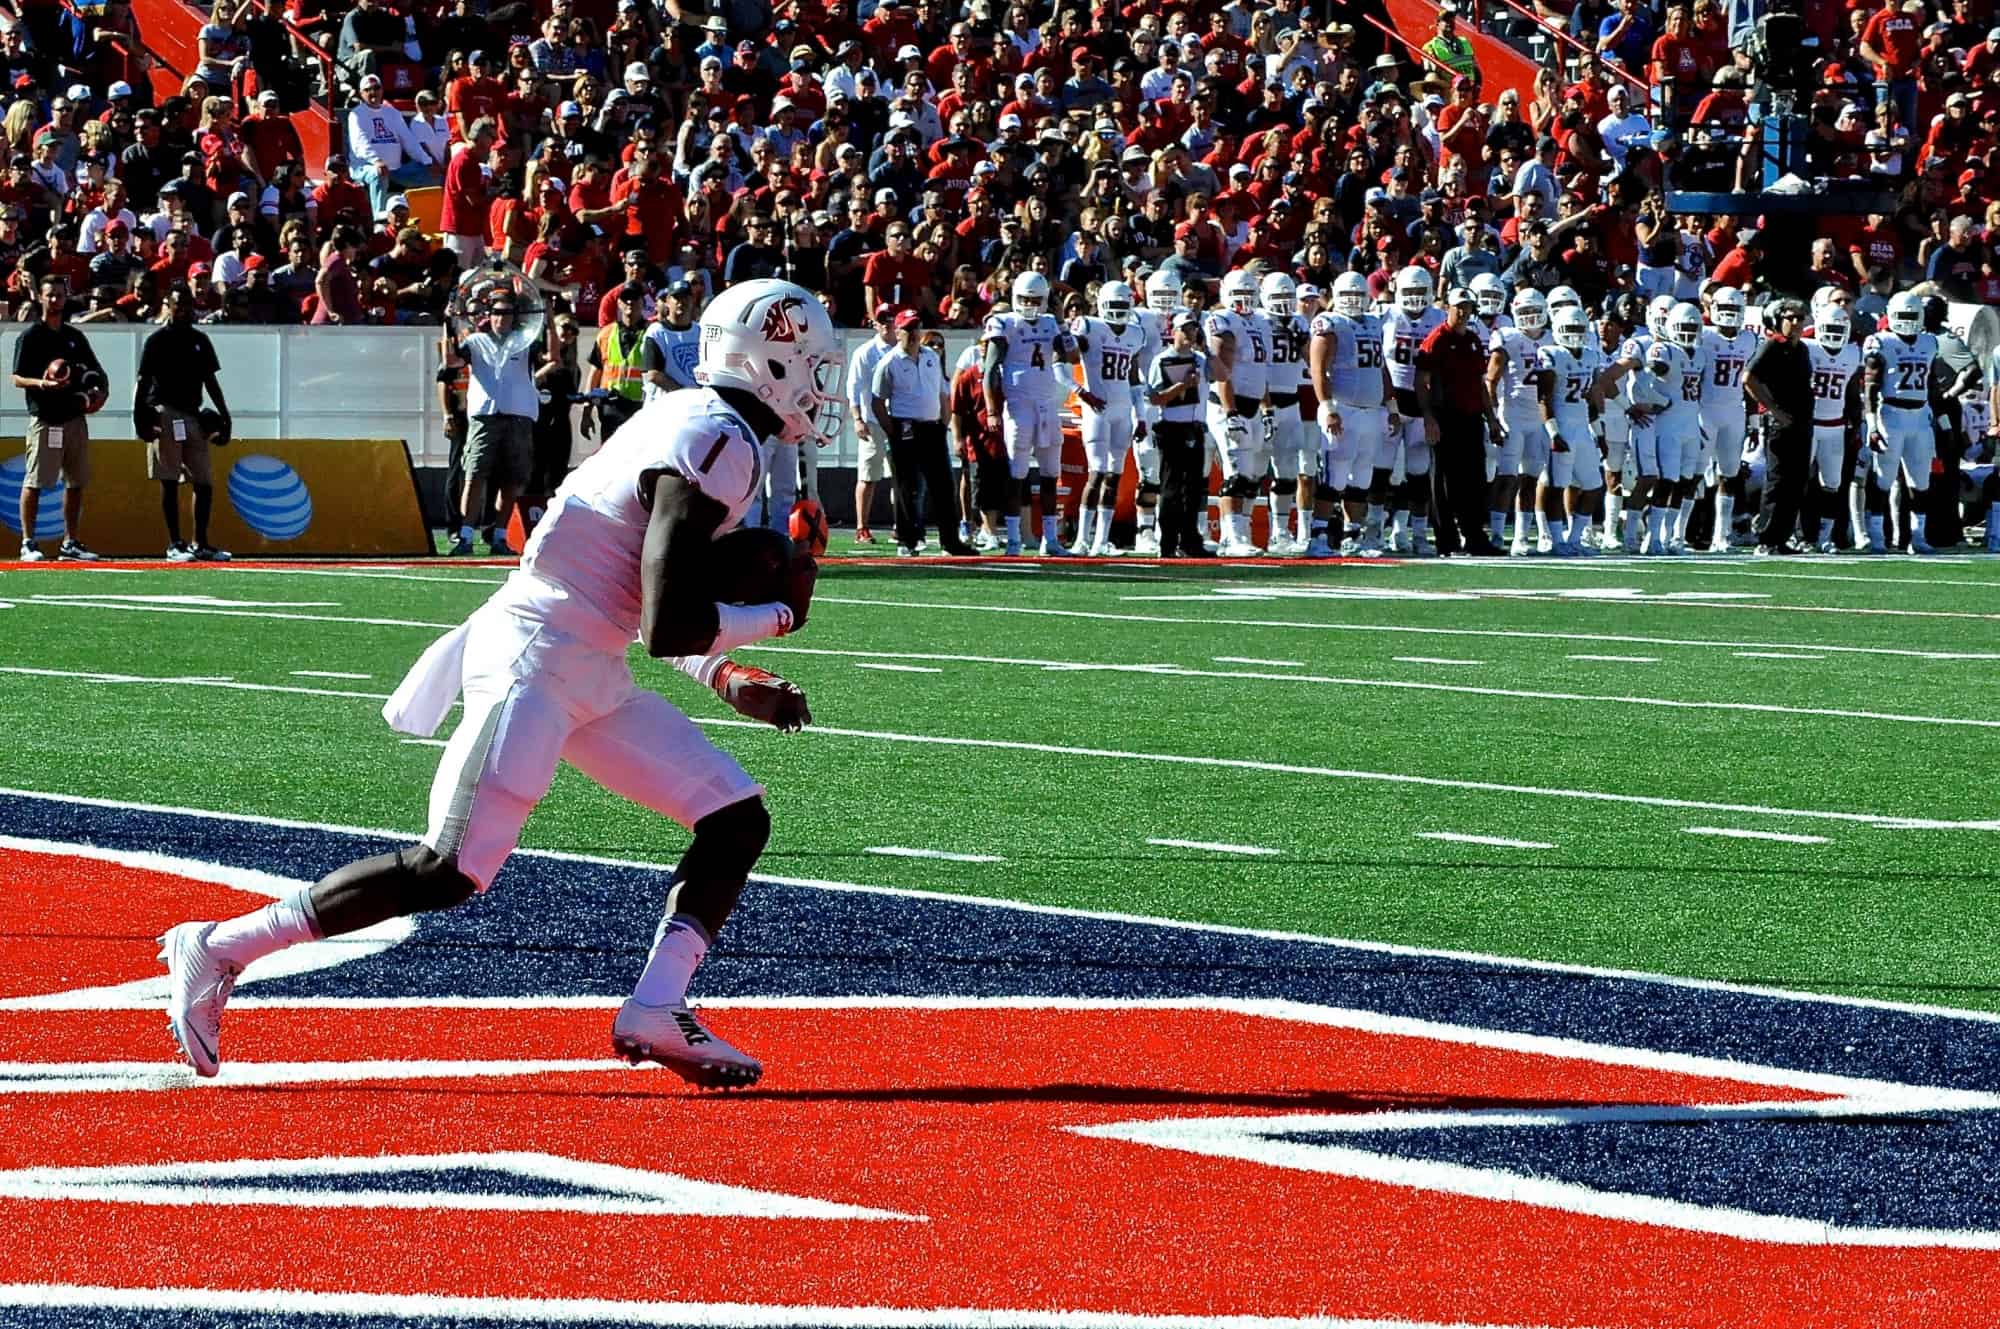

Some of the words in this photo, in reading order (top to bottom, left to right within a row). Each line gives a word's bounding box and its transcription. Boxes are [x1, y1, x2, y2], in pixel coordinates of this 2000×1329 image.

[1031, 343, 1044, 371] 4
[1101, 351, 1130, 380] 80
[1356, 338, 1384, 368] 58
[1714, 360, 1745, 388] 87
[1899, 361, 1927, 391] 23
[698, 432, 730, 475] 1
[671, 1010, 712, 1046] NIKE
